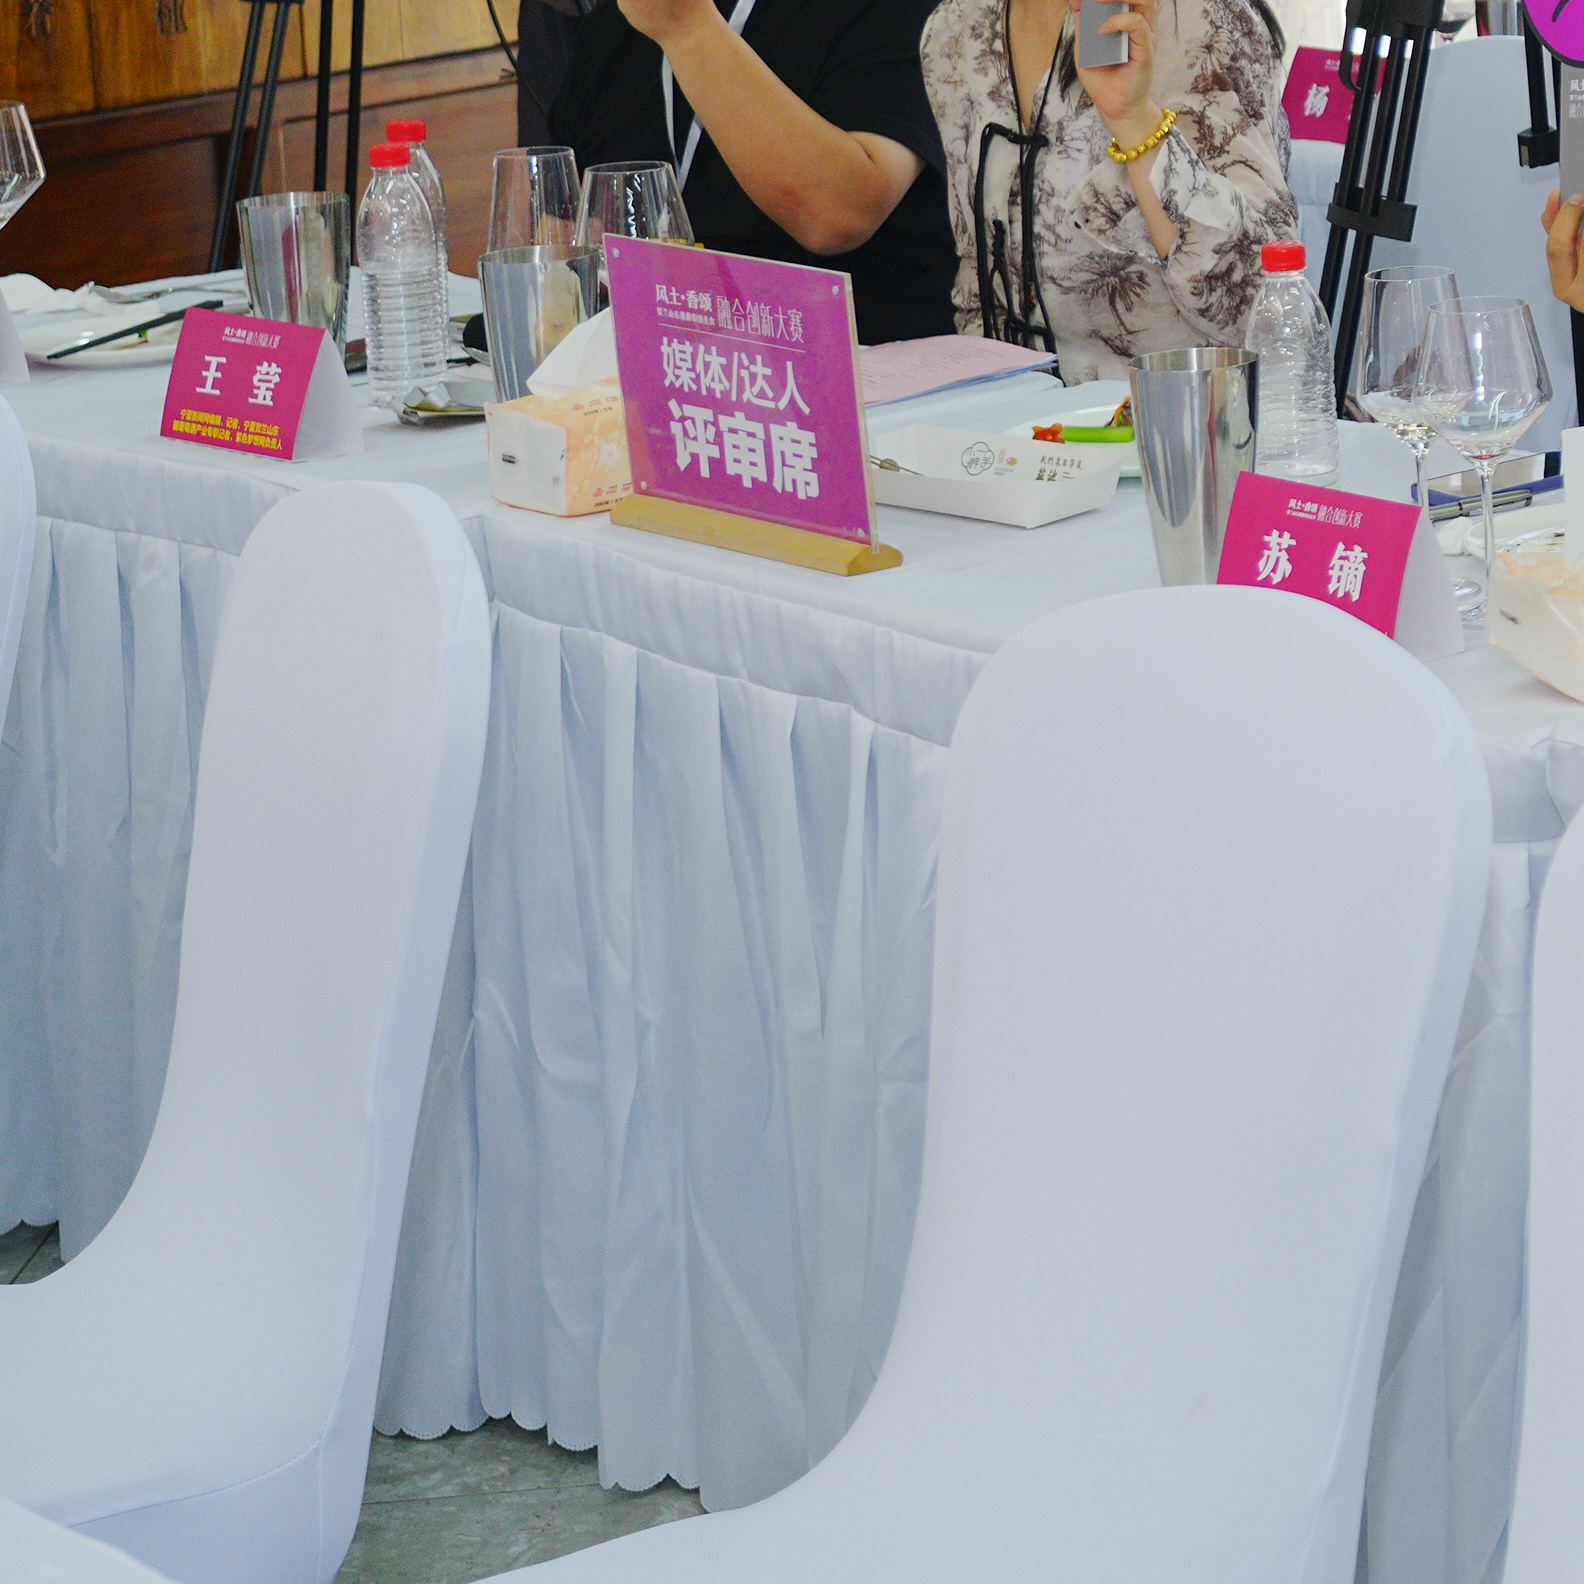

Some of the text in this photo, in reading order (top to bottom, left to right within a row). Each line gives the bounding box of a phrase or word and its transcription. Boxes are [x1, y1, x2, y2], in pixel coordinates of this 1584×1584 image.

[655, 283, 805, 343] 风土·香颂 融合创新大赛
[660, 336, 811, 416] 媒体/达人
[667, 398, 820, 500] 评审席
[1256, 528, 1297, 585] 苏
